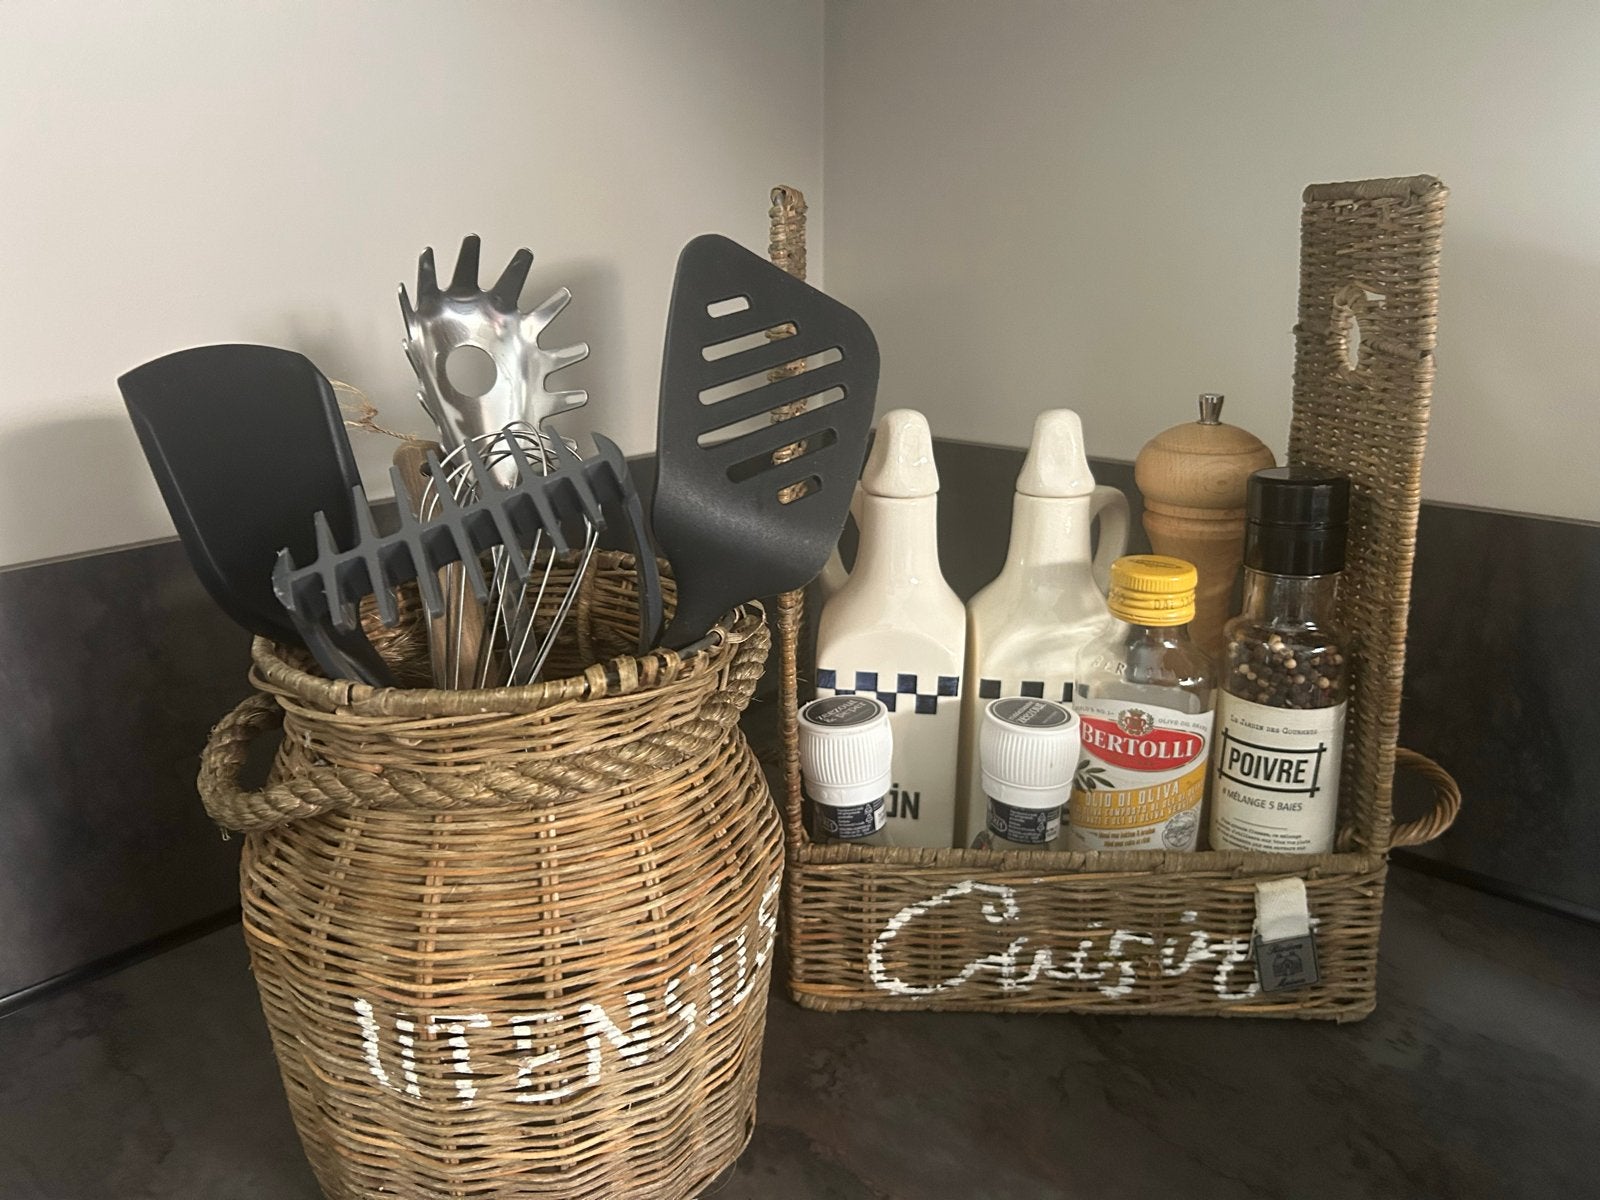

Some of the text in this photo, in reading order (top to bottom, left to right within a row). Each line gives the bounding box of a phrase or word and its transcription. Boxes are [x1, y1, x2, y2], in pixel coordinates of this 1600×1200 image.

[1081, 720, 1194, 759] BERTOLLI
[1228, 747, 1309, 784] POIVRE
[1085, 791, 1111, 807] OLIO
[1138, 780, 1179, 805] OLIVA
[1268, 801, 1275, 810] 5
[1277, 802, 1303, 812] BAIES
[869, 880, 1319, 1000] Cuisin
